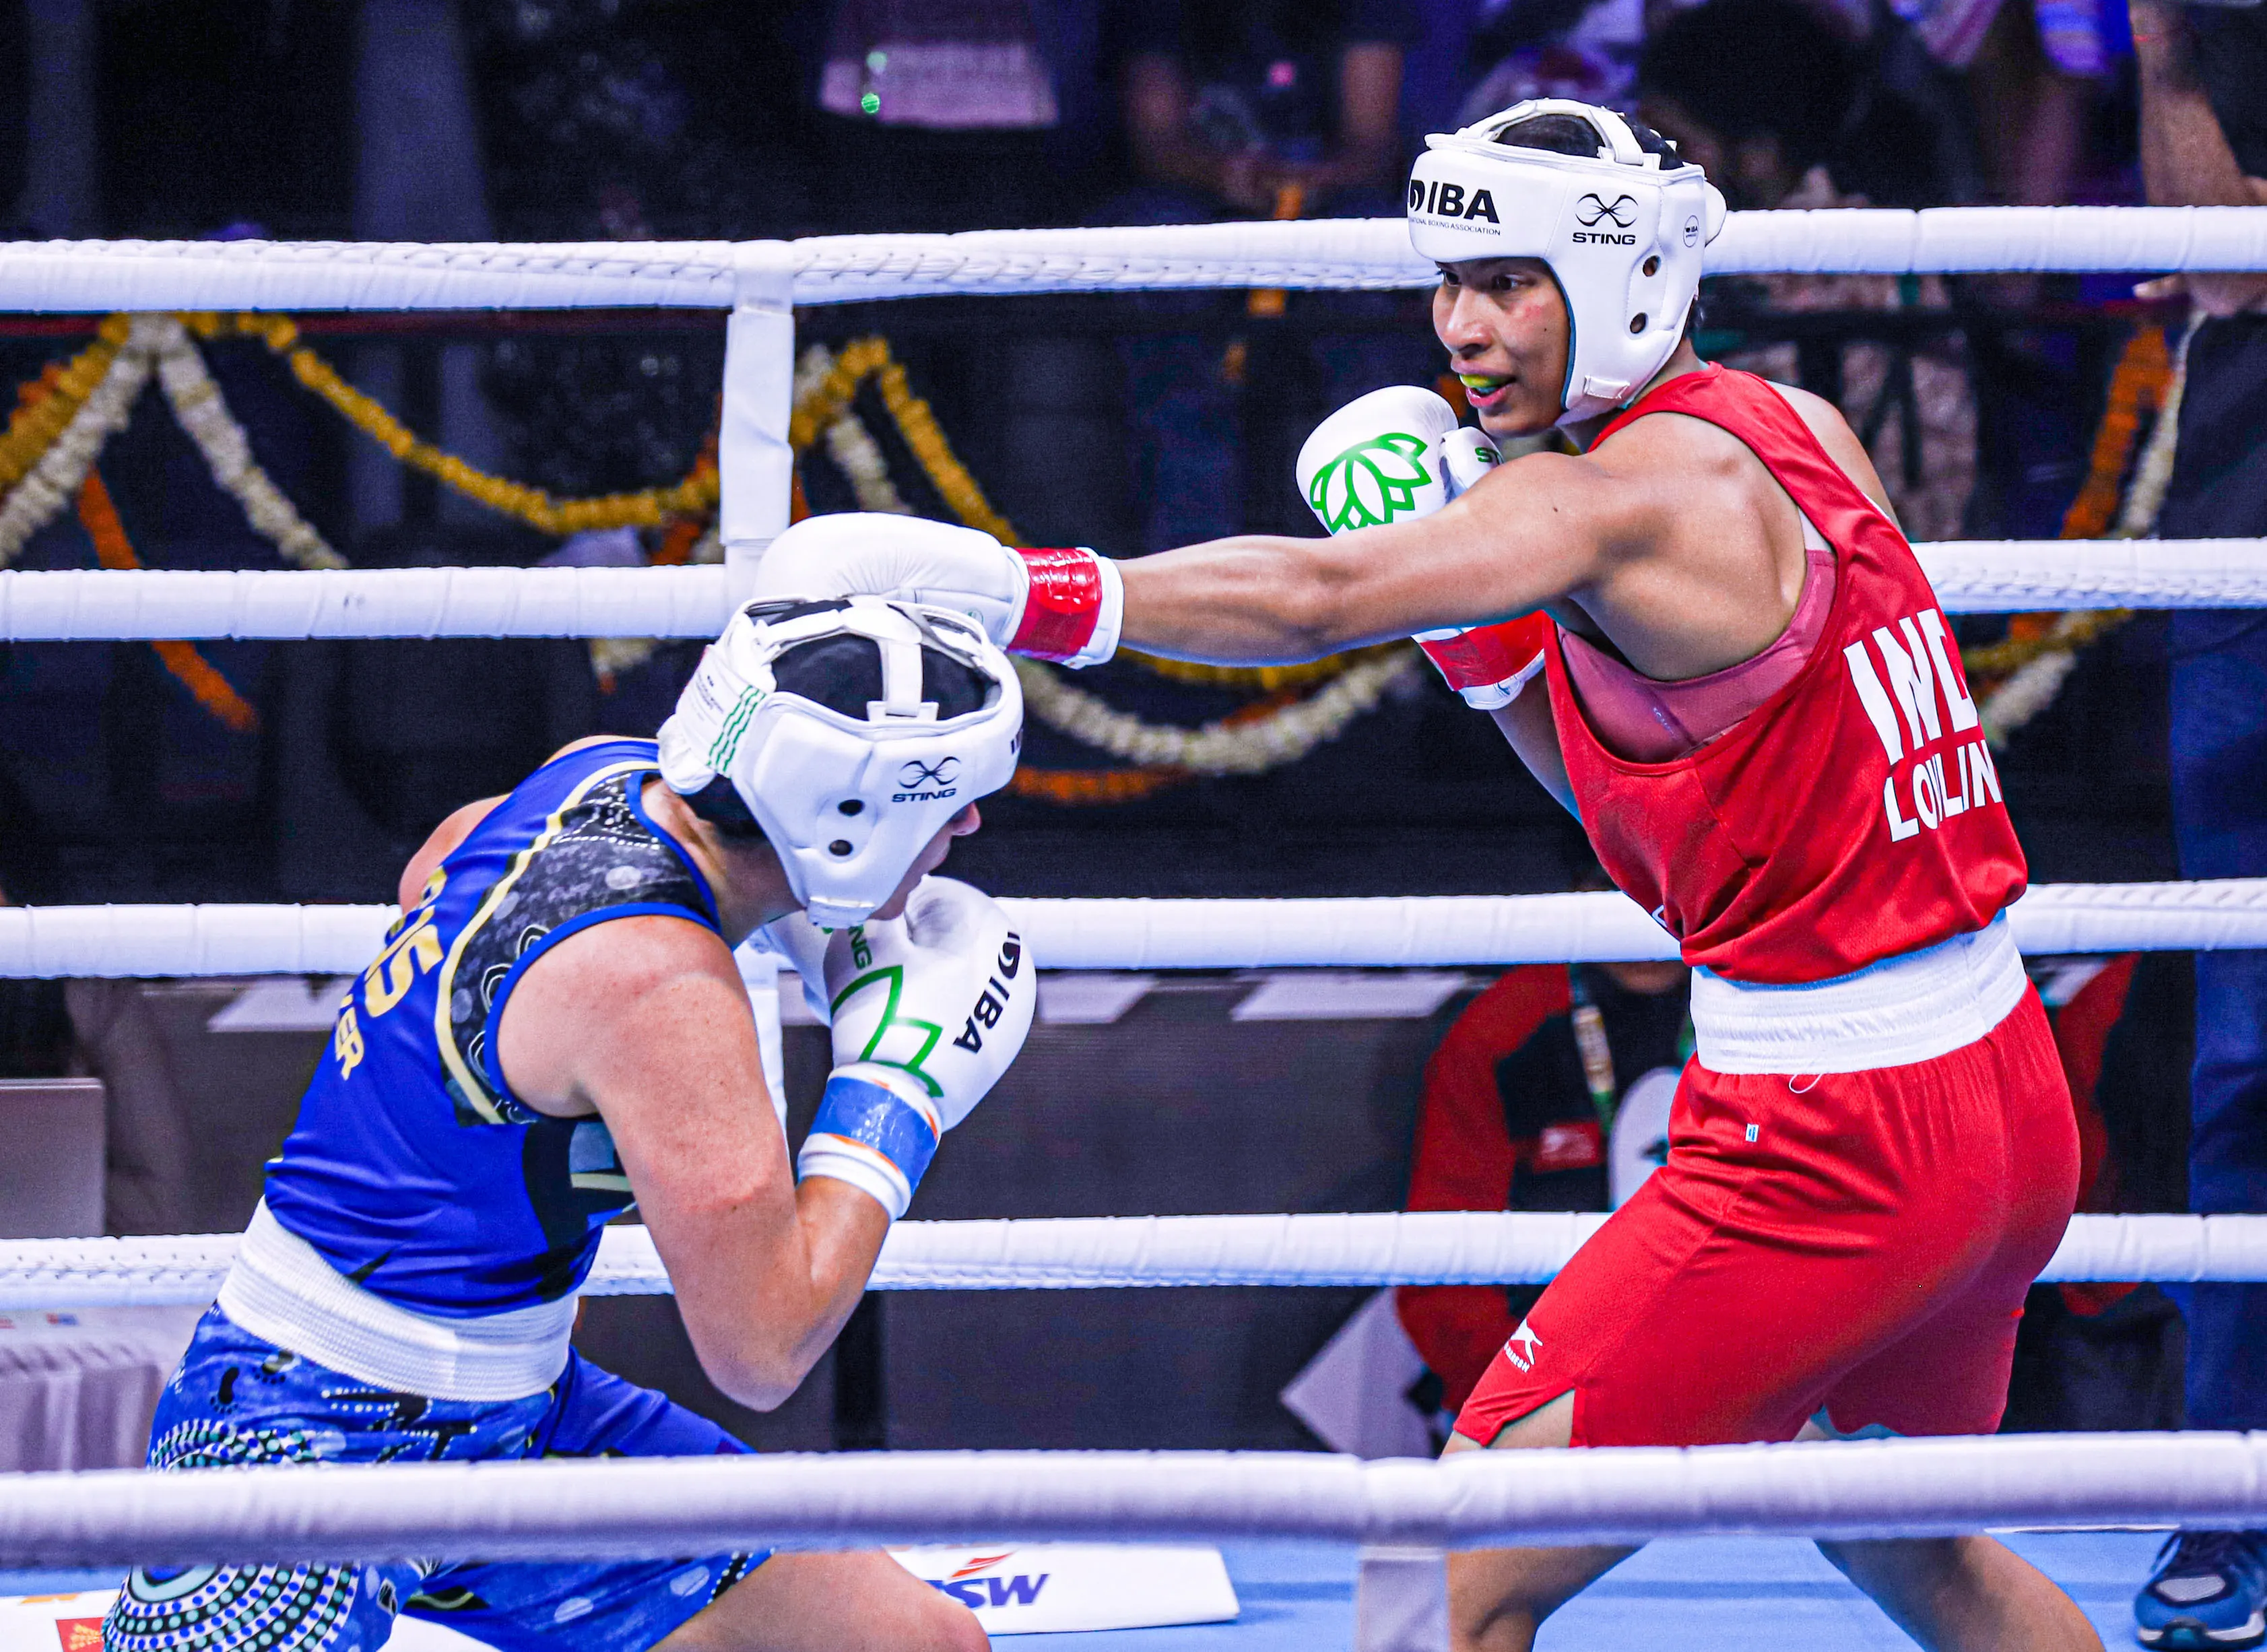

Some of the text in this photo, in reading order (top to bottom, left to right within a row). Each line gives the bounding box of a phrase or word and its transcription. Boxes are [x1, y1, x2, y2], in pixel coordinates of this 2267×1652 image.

[1427, 181, 1501, 224] IBA
[1428, 220, 1449, 228] BOXING
[1450, 223, 1501, 236] ASSOCIATION
[1572, 232, 1636, 245] STING
[892, 788, 956, 803] STING
[952, 976, 1010, 1054] IBA
[923, 1573, 1051, 1609] SW
